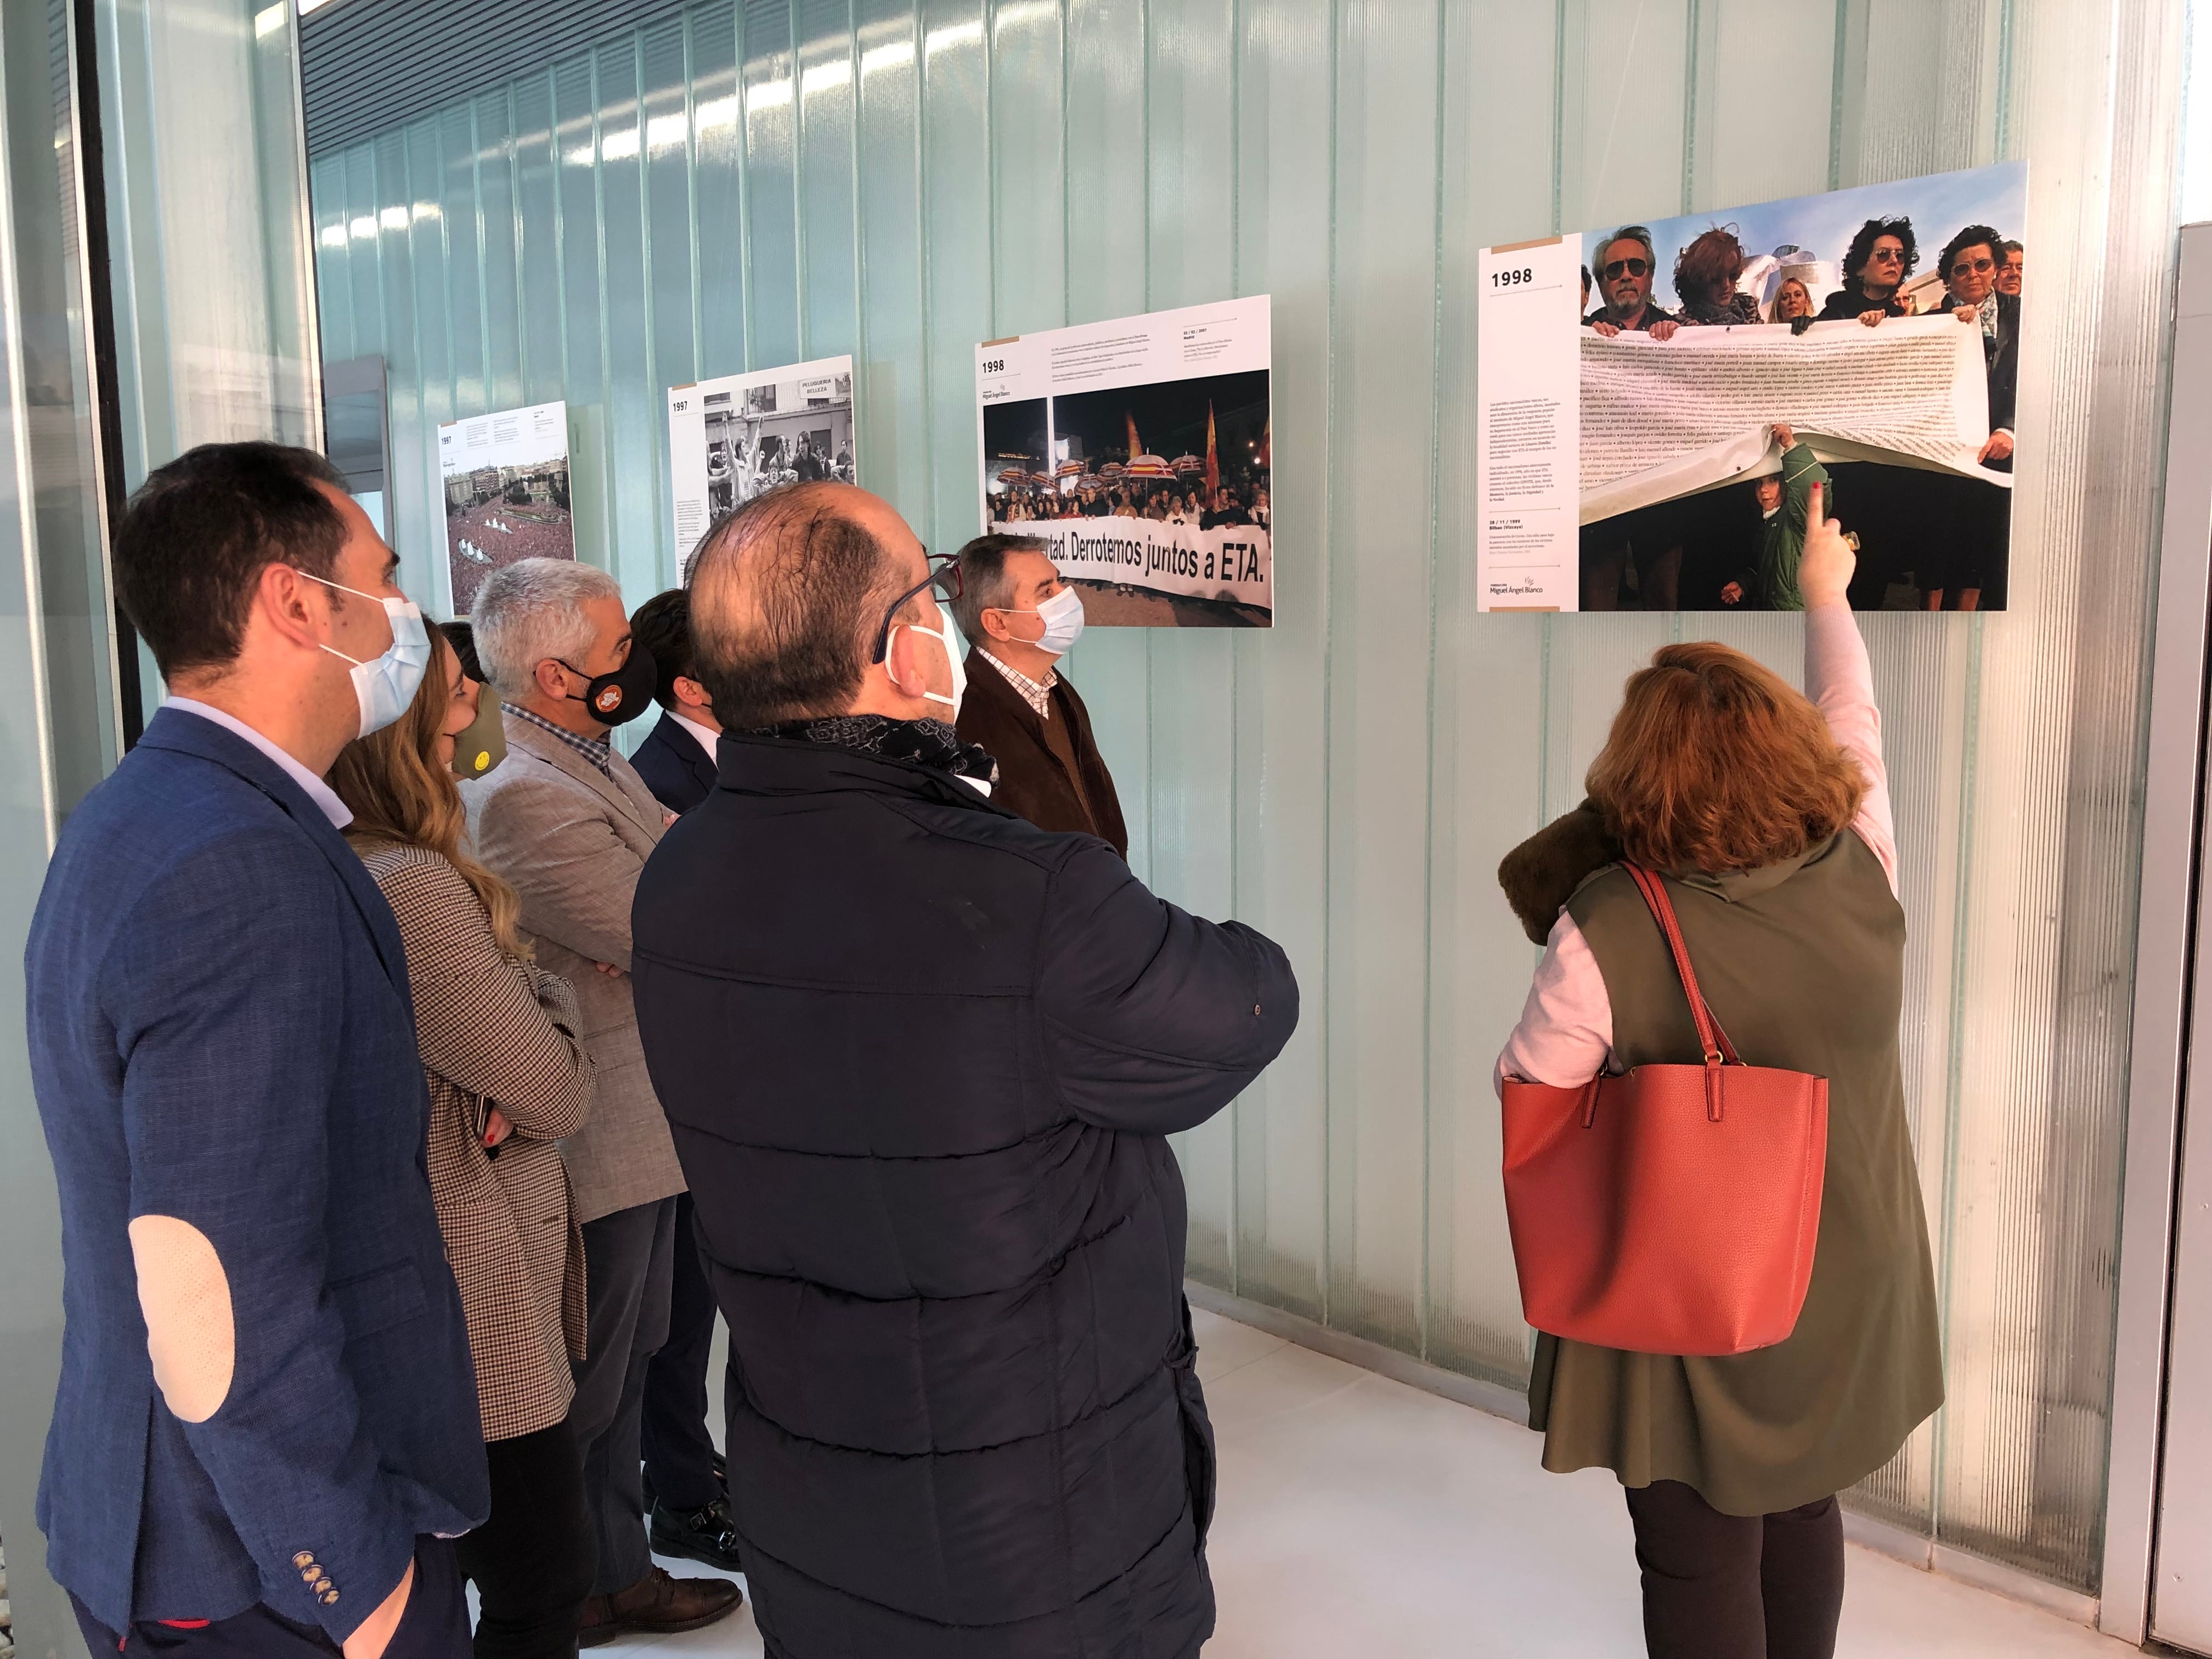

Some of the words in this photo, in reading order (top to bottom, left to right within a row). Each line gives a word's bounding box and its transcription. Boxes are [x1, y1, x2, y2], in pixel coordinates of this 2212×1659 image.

[1492, 268, 1532, 287] 1998
[983, 359, 1004, 374] 1998
[802, 379, 832, 388] PELUQUERIA
[673, 401, 687, 412] 1997
[441, 436, 452, 445] 1997
[1071, 531, 1142, 567] Derrotemos
[1144, 534, 1199, 578] juntos
[1204, 551, 1215, 580] a
[1220, 542, 1264, 583] ETA.
[1489, 586, 1508, 595] Miguel
[1508, 585, 1525, 595] Ángel
